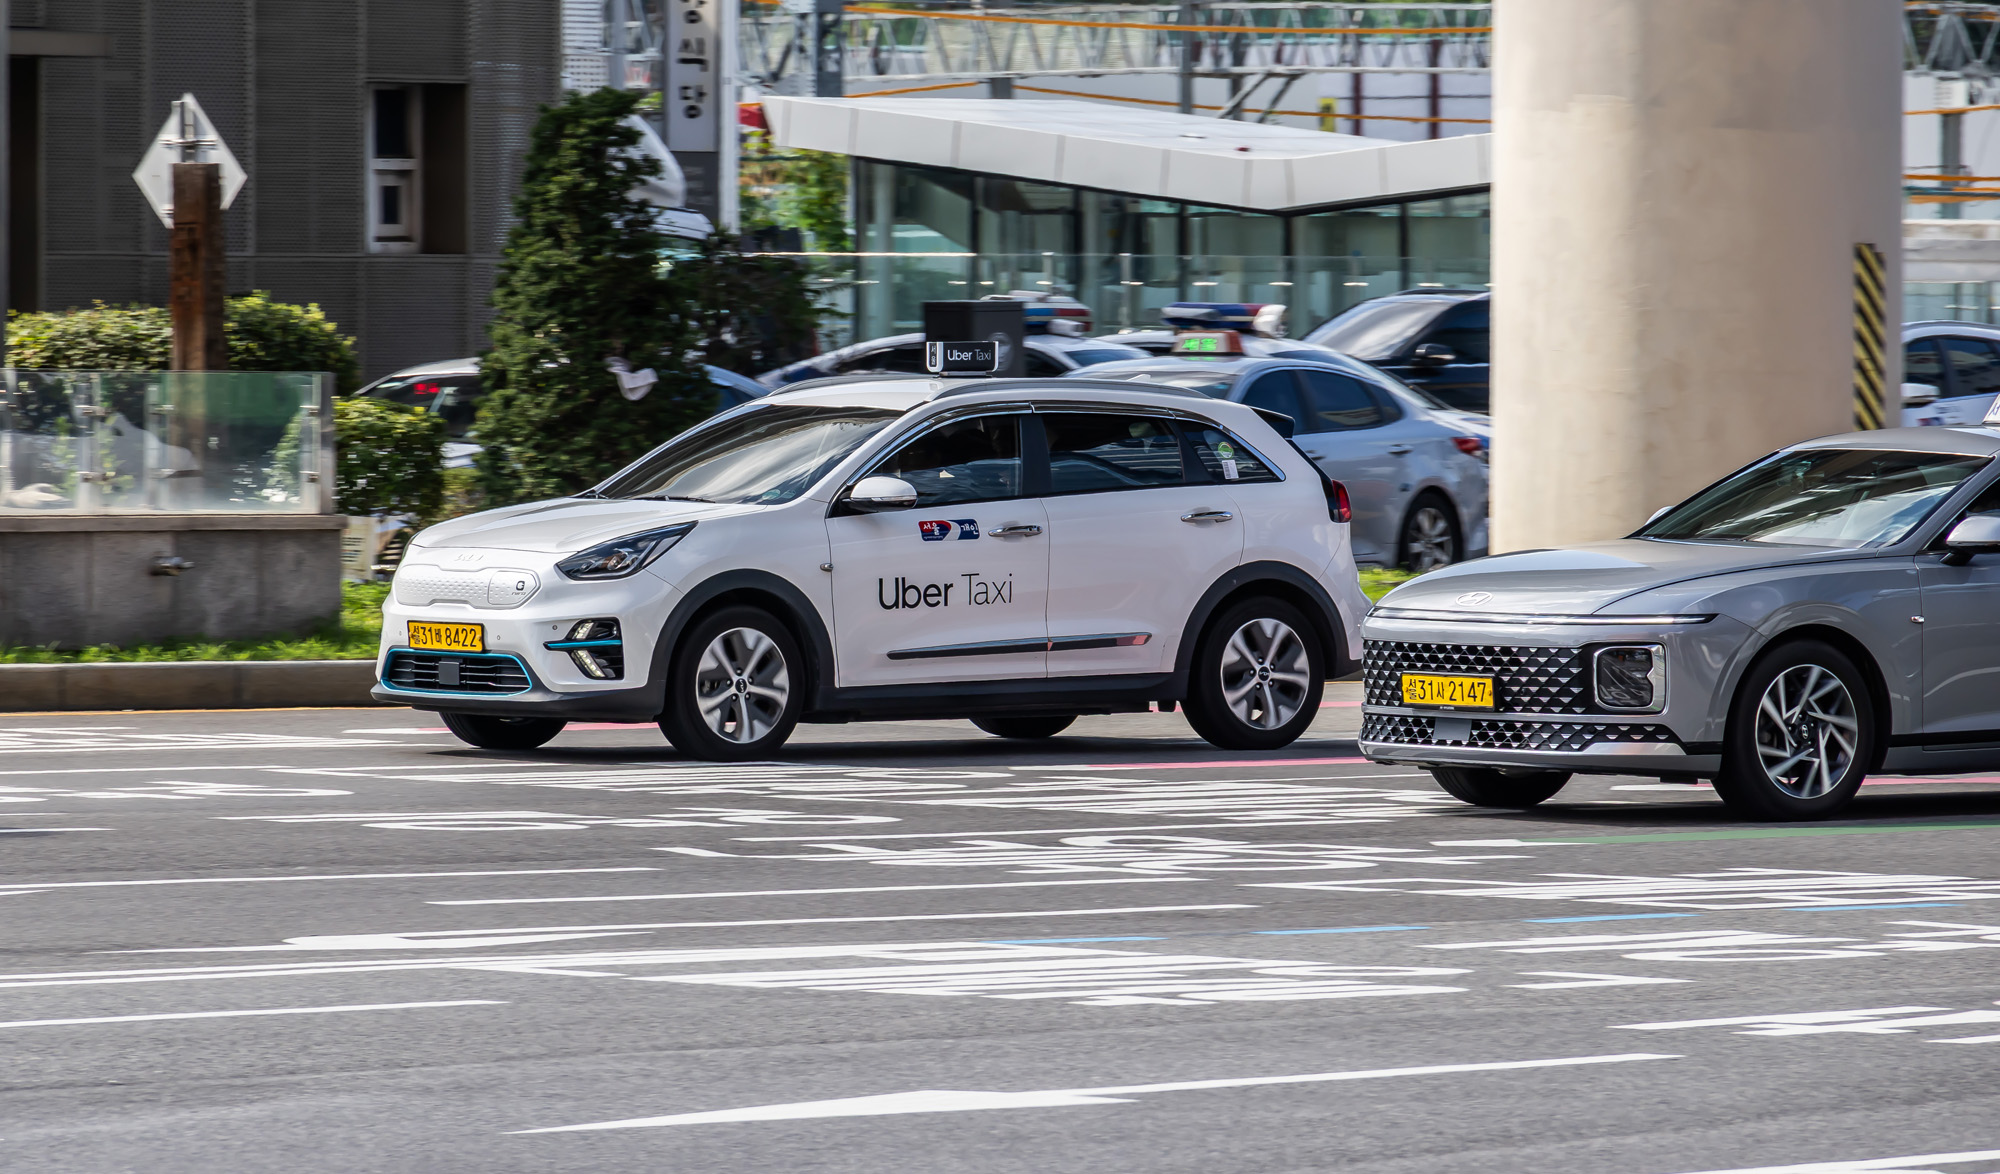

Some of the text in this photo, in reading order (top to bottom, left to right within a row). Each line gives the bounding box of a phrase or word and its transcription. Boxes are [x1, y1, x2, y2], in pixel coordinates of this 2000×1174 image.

[677, 0, 709, 119] 식당
[947, 348, 992, 361] Uber Taxi
[878, 573, 1013, 610] Uber Taxi
[413, 625, 421, 645] 서울
[444, 626, 477, 648] 8422
[1408, 678, 1487, 702] 서울 31사 2147
